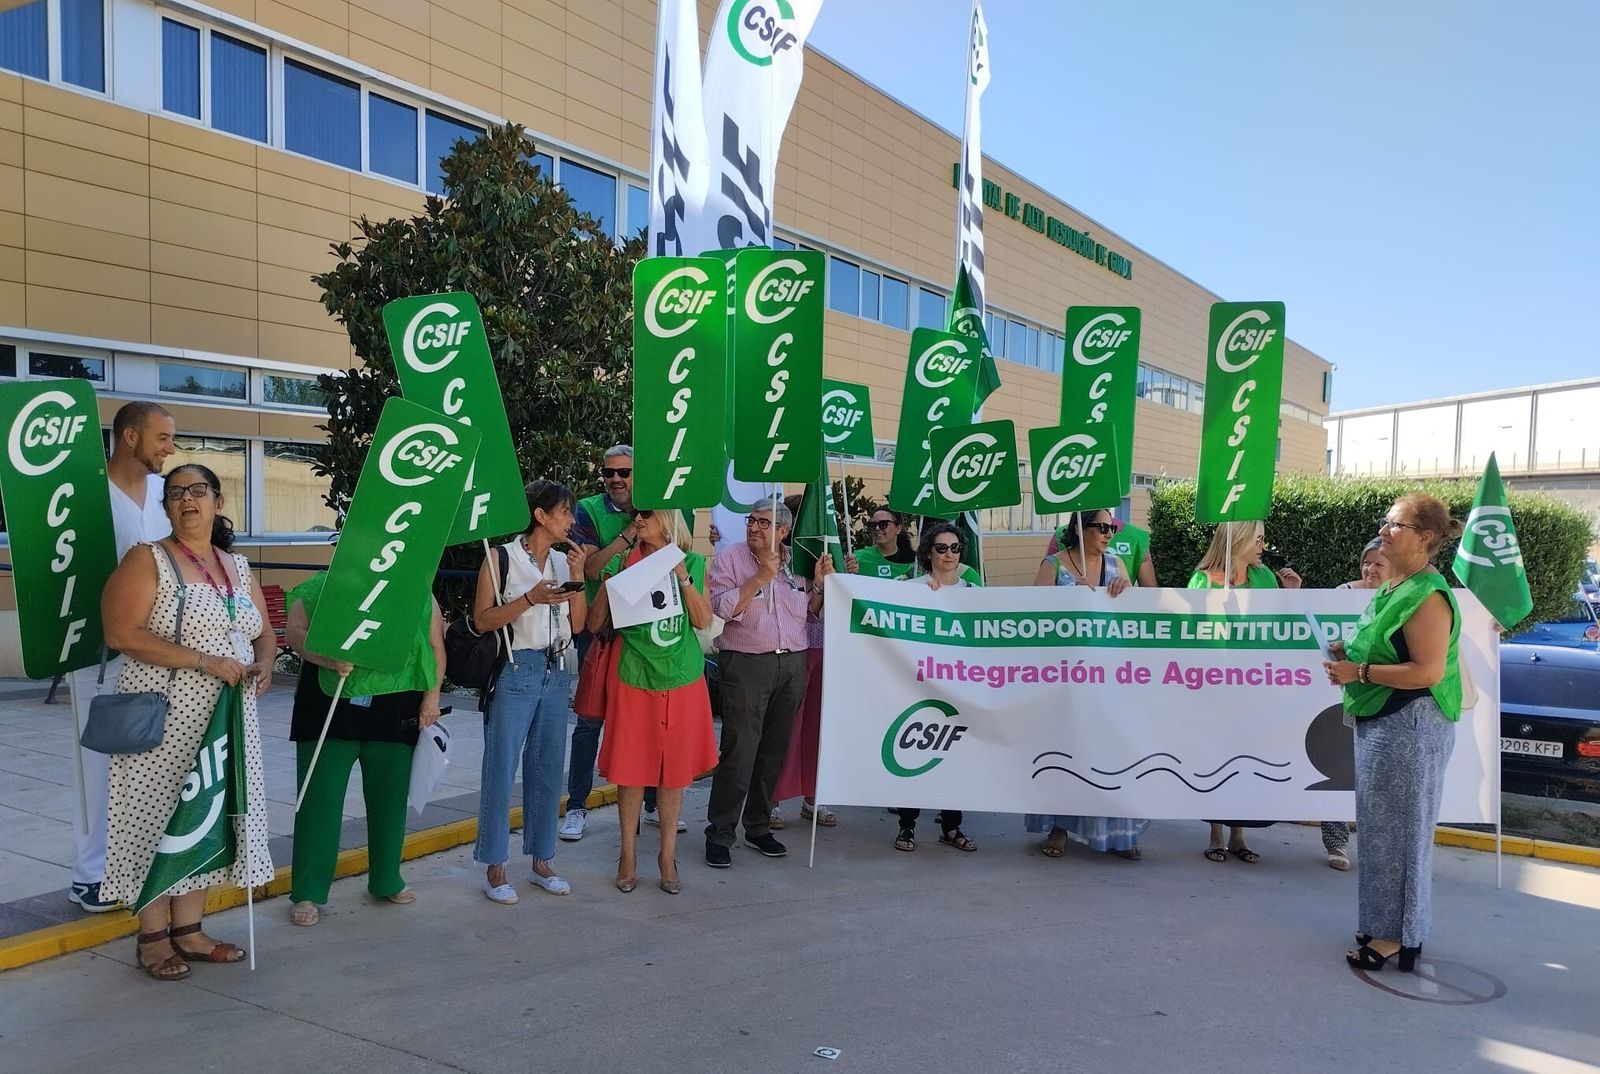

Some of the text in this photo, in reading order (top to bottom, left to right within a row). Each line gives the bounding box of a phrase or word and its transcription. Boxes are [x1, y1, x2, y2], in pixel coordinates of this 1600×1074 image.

[744, 6, 797, 55] CSIF
[1005, 192, 1020, 221] DE
[1022, 202, 1045, 233] ALTA
[658, 288, 717, 314] CSIF
[759, 278, 815, 302] CSIF
[417, 321, 472, 350] CSIF
[1084, 329, 1132, 348] CSIF
[1228, 328, 1276, 351] CSIF
[927, 353, 973, 375] CSIF
[24, 414, 88, 448] CSIF
[822, 405, 864, 429] CSIF
[397, 438, 464, 474] CSIF
[951, 451, 1007, 480] CSIF
[1050, 452, 1107, 481] CSIF
[860, 607, 926, 635] ANTE
[934, 617, 966, 638] LA
[973, 618, 1172, 640] INSOPORTABLE
[1180, 620, 1312, 641] LENTITUD
[916, 655, 1312, 690] ¡Integración de Agencias
[898, 721, 969, 752] CSIF
[1534, 742, 1561, 755] KFP
[180, 734, 228, 802] SIF
